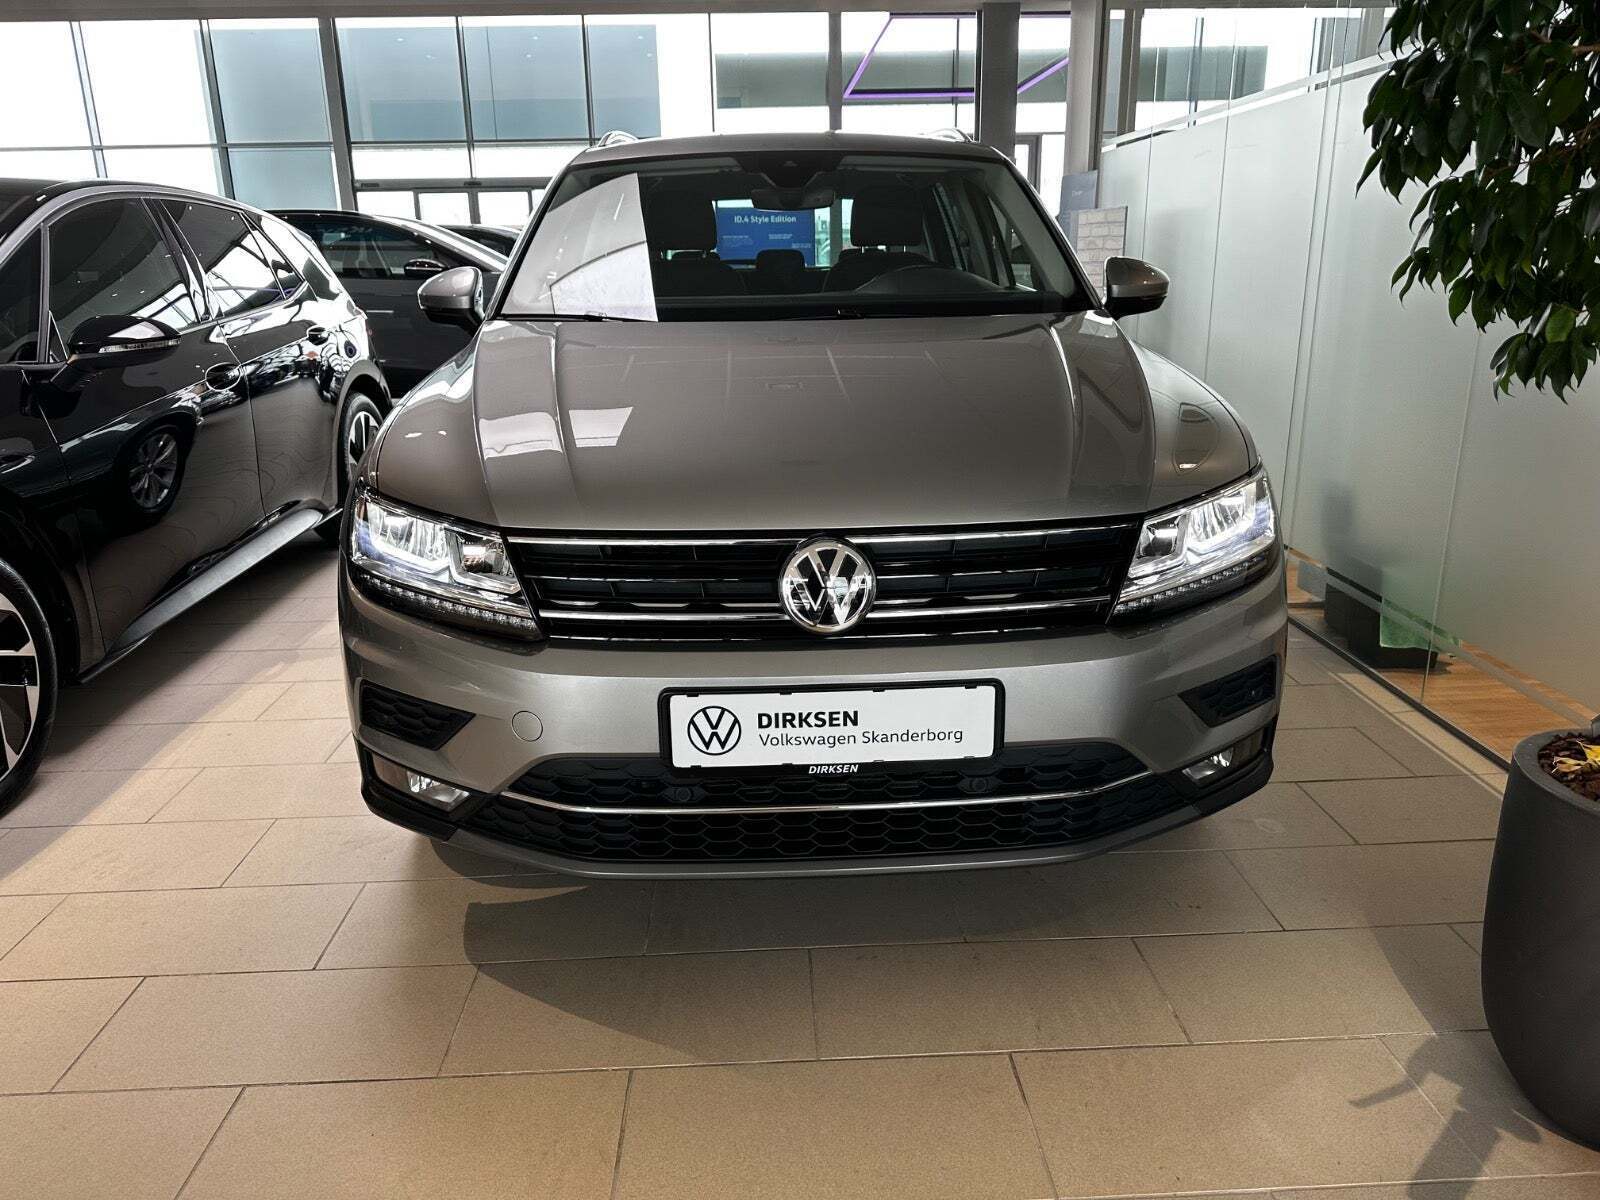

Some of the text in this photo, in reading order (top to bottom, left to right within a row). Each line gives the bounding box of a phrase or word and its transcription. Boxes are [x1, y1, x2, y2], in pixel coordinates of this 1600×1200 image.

[734, 215, 797, 224] ID.4 Style Edition
[758, 711, 859, 729] DIRKSEN
[758, 729, 963, 747] Volkswagen Skanderborg
[808, 763, 859, 774] DIRKSEN
